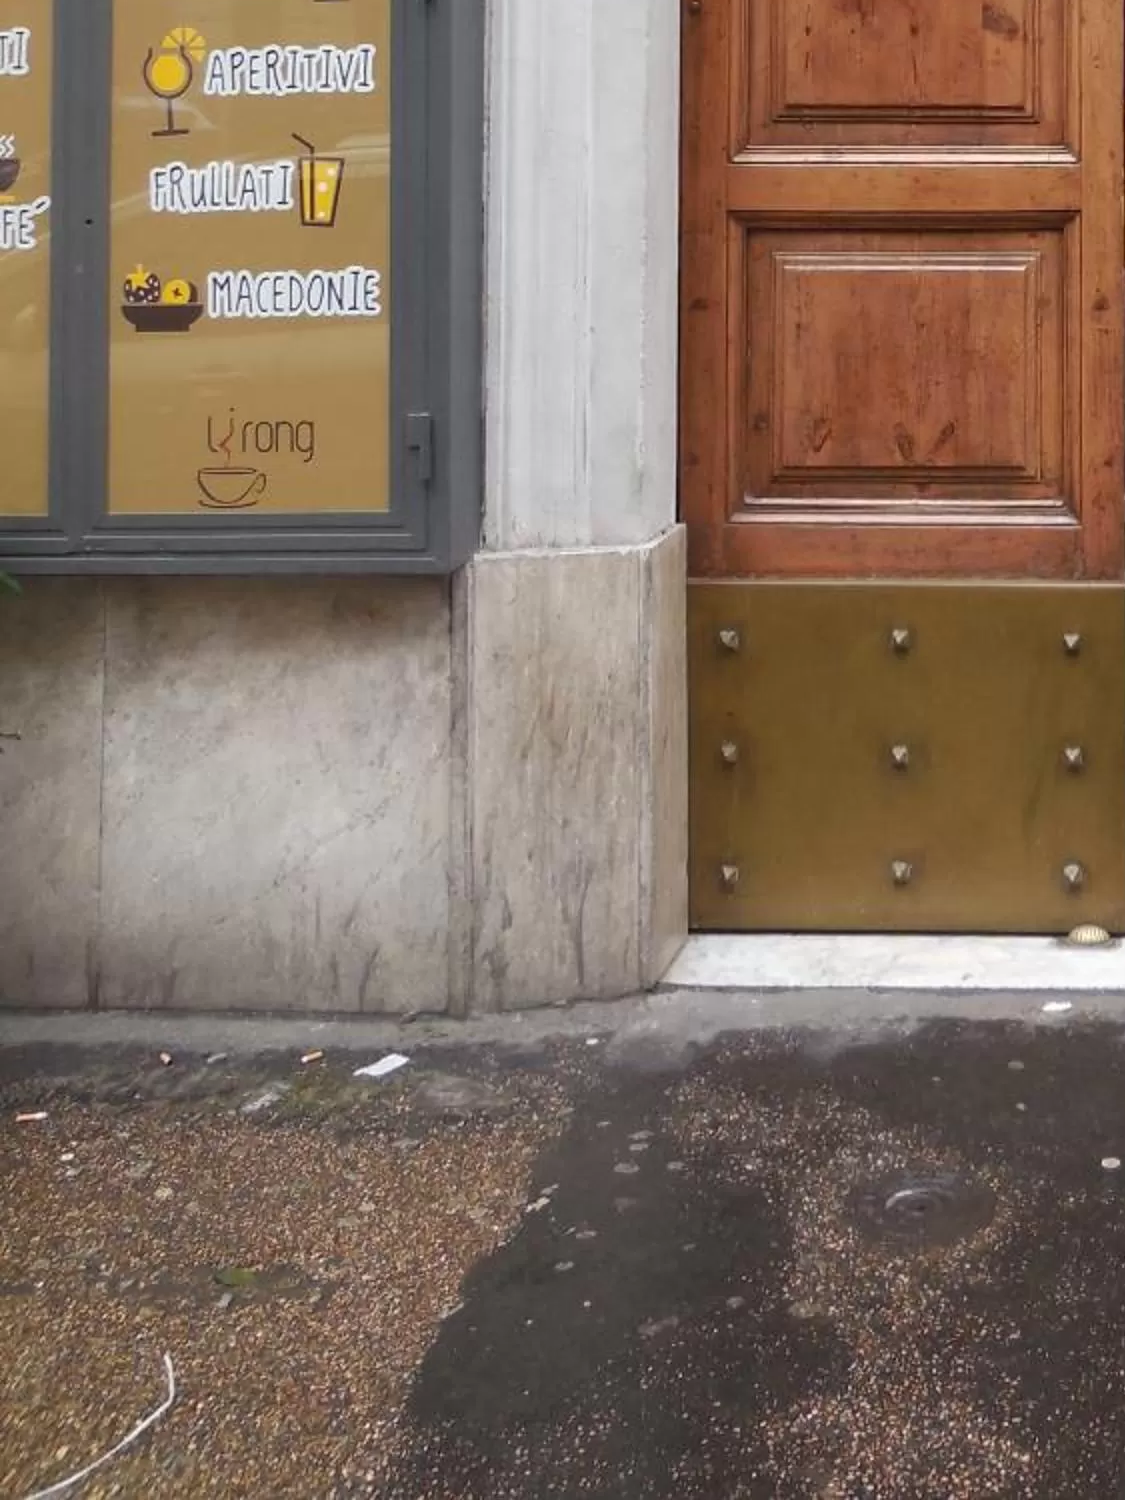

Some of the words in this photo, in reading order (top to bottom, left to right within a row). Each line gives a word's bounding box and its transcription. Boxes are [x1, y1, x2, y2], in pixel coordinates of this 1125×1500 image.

[204, 47, 374, 92] APERITIVI
[152, 162, 293, 210] FRULLATI
[209, 268, 381, 315] MACEDONIE
